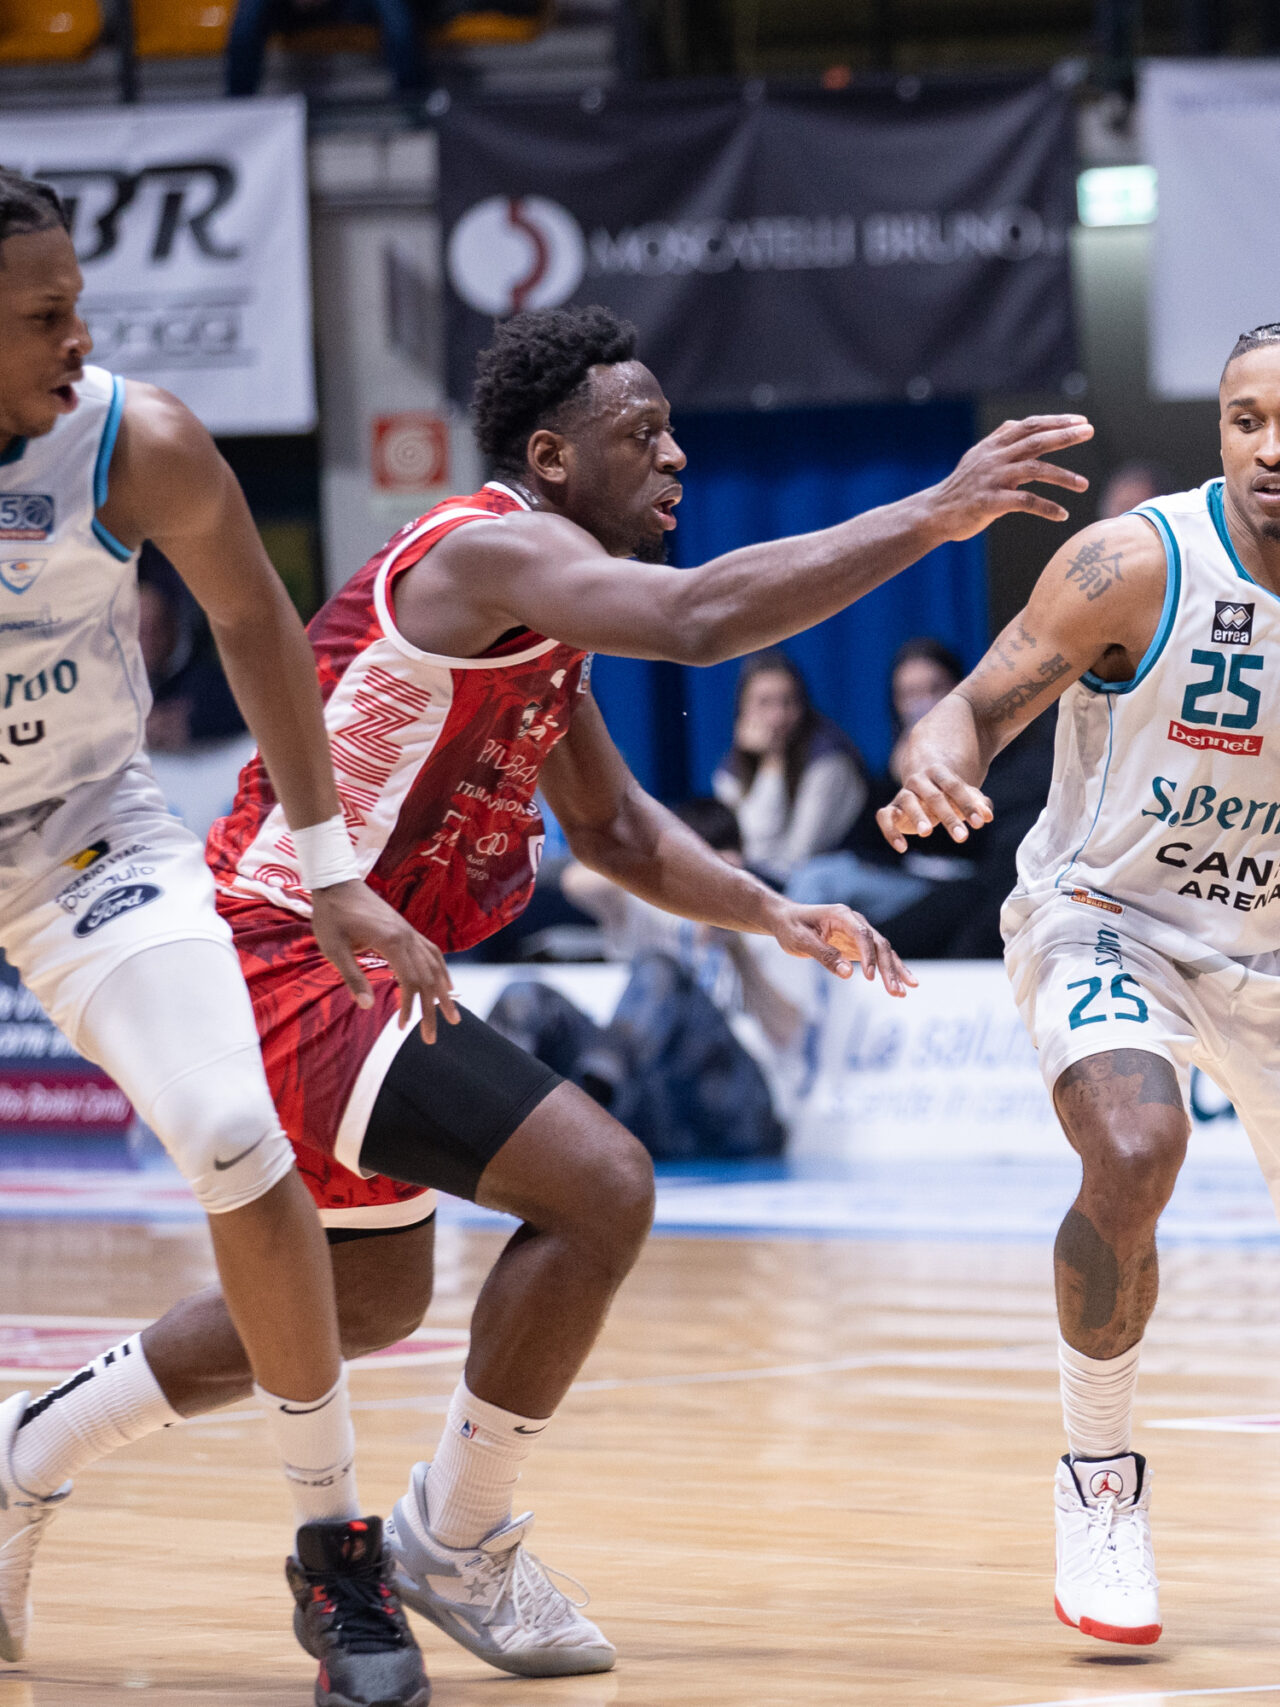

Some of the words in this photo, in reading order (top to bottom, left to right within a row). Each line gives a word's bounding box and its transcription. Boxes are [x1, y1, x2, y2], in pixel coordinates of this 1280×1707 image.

[1181, 648, 1265, 730] 25
[1171, 724, 1257, 753] bennet
[86, 888, 145, 928] Ford
[1066, 972, 1149, 1031] 25
